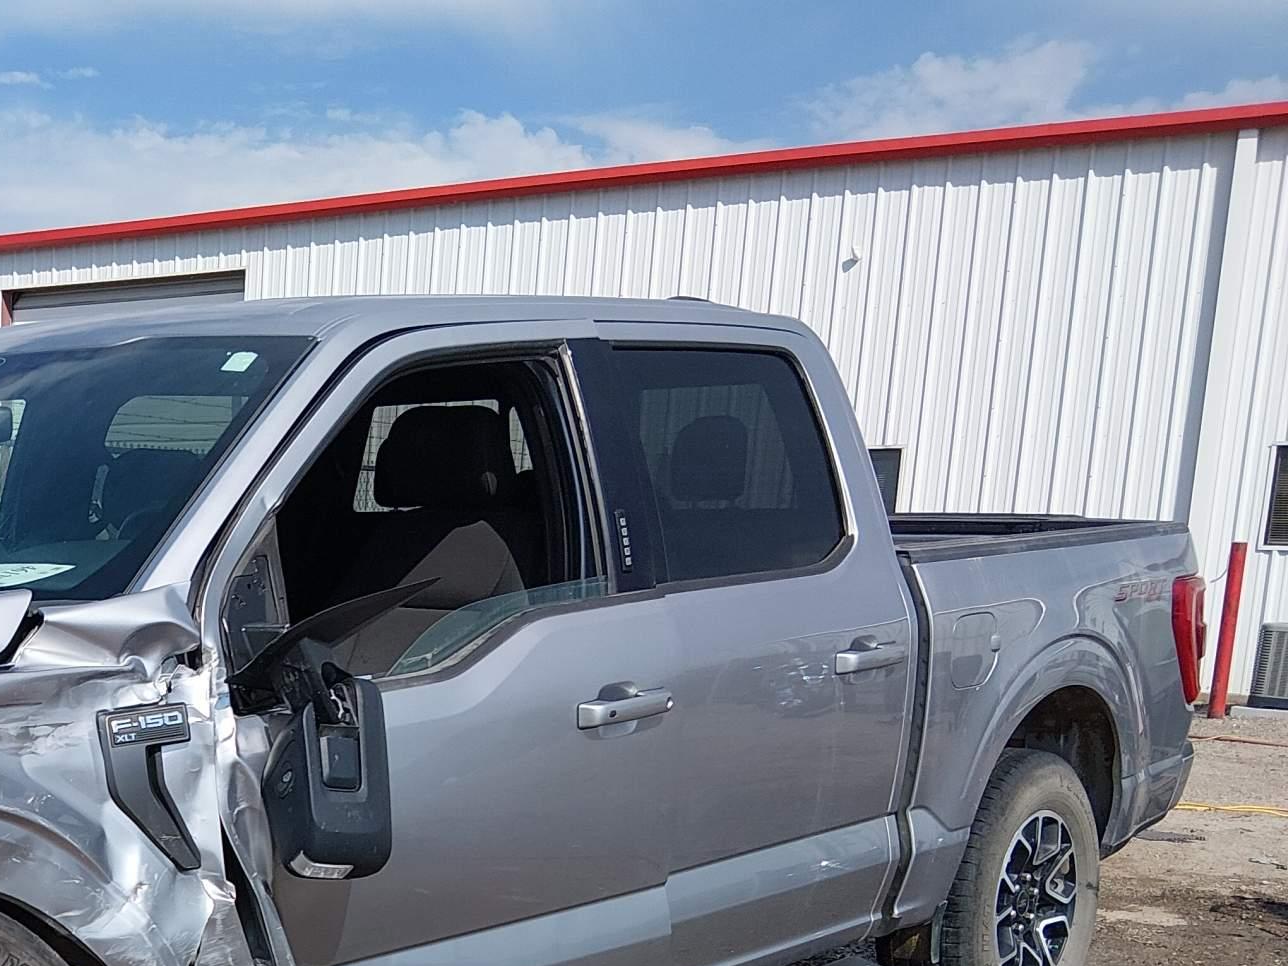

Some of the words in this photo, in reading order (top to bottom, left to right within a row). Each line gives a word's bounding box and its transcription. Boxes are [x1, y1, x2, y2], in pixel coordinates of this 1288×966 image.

[1113, 576, 1167, 602] SPORT
[110, 711, 184, 734] F-150
[115, 733, 137, 744] XLT
